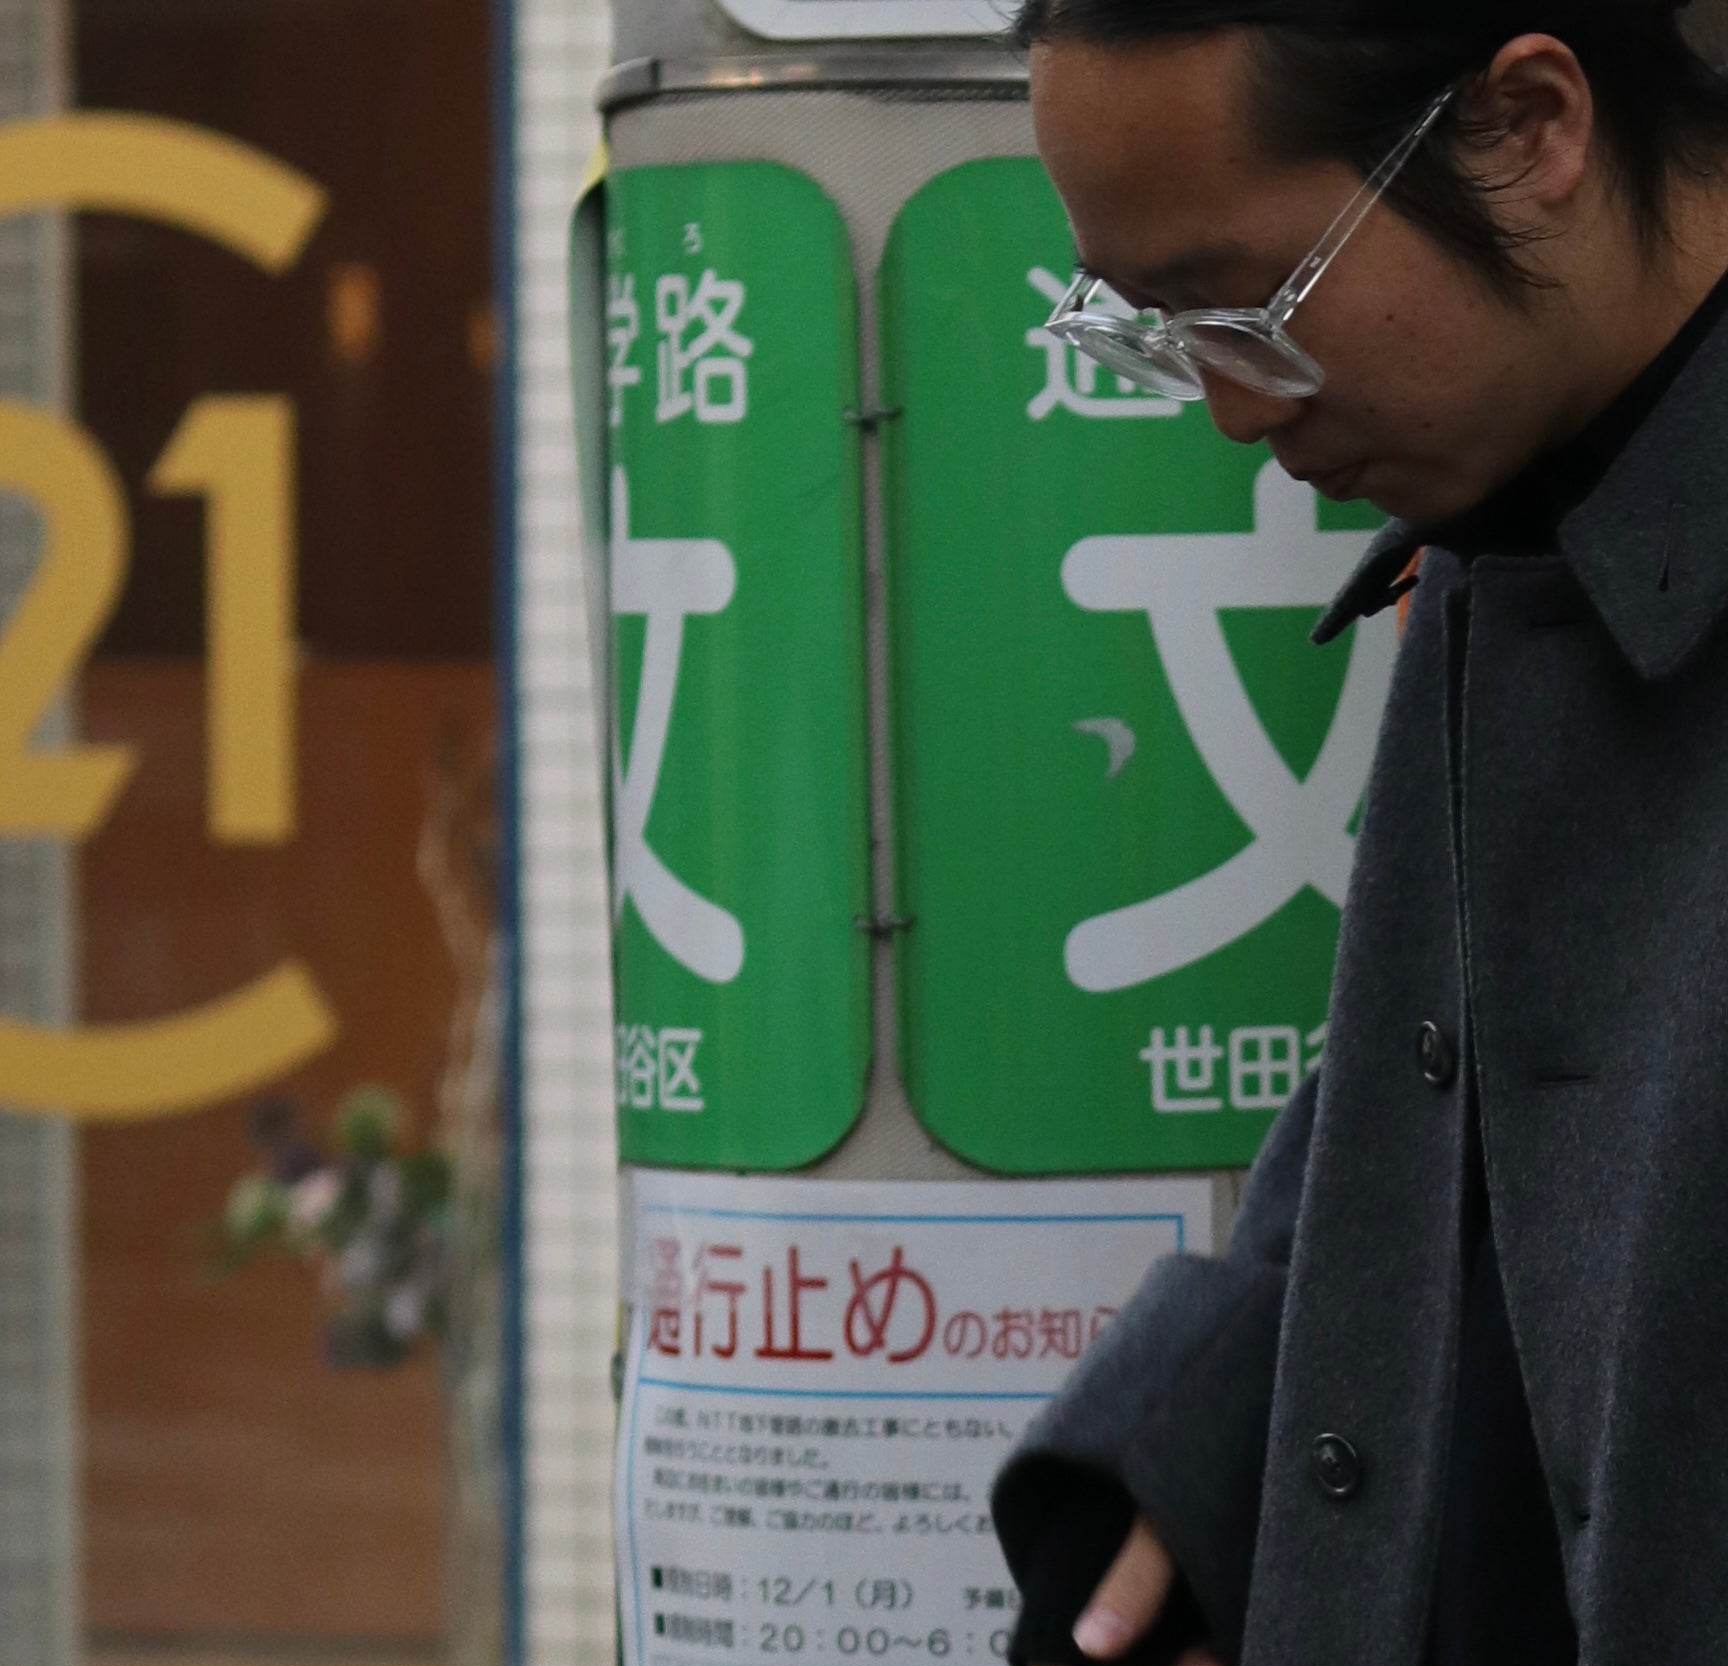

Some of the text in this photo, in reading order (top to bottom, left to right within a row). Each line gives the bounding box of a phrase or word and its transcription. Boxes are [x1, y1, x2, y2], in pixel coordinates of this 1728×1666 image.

[617, 1024, 705, 1112] 谷区
[1139, 1024, 1330, 1114] 世田
[963, 1586, 1022, 1611] 予備
